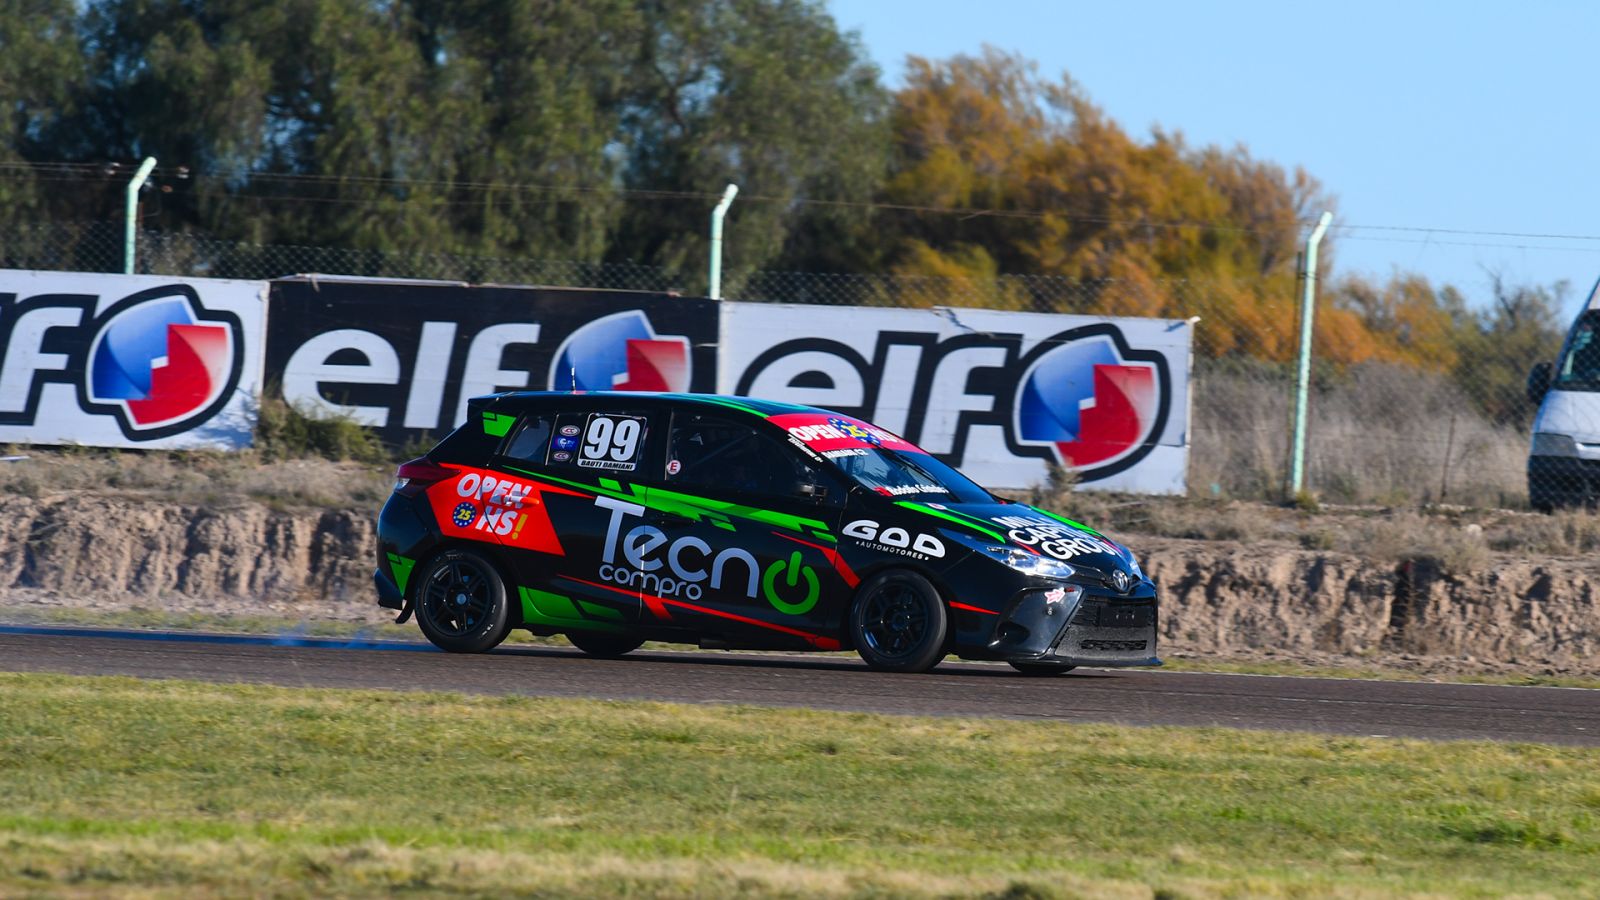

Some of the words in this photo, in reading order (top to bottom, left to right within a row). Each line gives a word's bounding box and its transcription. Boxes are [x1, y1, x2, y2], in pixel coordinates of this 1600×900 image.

[282, 321, 541, 429] elf
[738, 334, 1018, 464] elf
[584, 417, 640, 461] 99
[788, 424, 847, 441] OPEN
[603, 462, 633, 470] DAMIANI
[670, 463, 678, 472] E
[457, 473, 532, 508] OPEN
[457, 509, 471, 521] 25
[599, 564, 702, 600] compro
